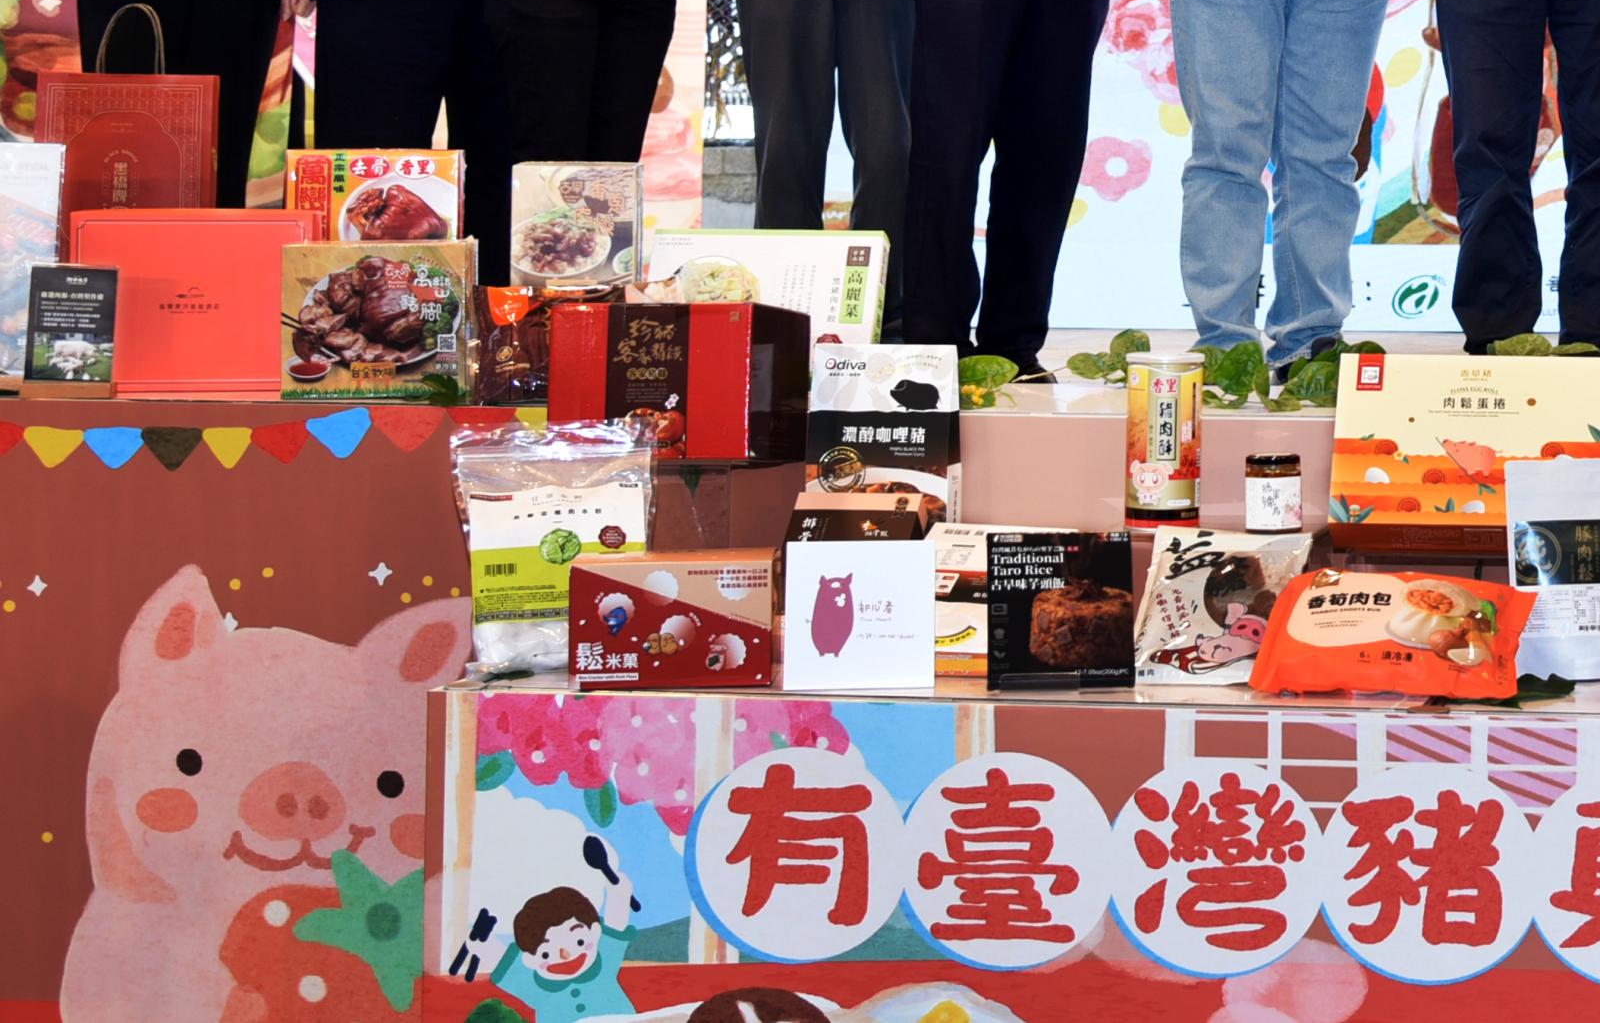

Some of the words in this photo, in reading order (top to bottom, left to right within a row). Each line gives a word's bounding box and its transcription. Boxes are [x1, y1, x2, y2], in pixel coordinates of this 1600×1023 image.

[351, 159, 388, 177] 去骨
[399, 159, 432, 176] 香里
[844, 270, 863, 318] 高麗菜
[1152, 378, 1177, 394] 香里
[1158, 401, 1174, 456] 豬肉酥
[991, 553, 1065, 565] Traditional
[991, 565, 1022, 576] Taro
[1025, 565, 1053, 575] Rice
[991, 577, 1066, 591] 古早味芋頭飯
[1306, 591, 1392, 610] 香筍肉包
